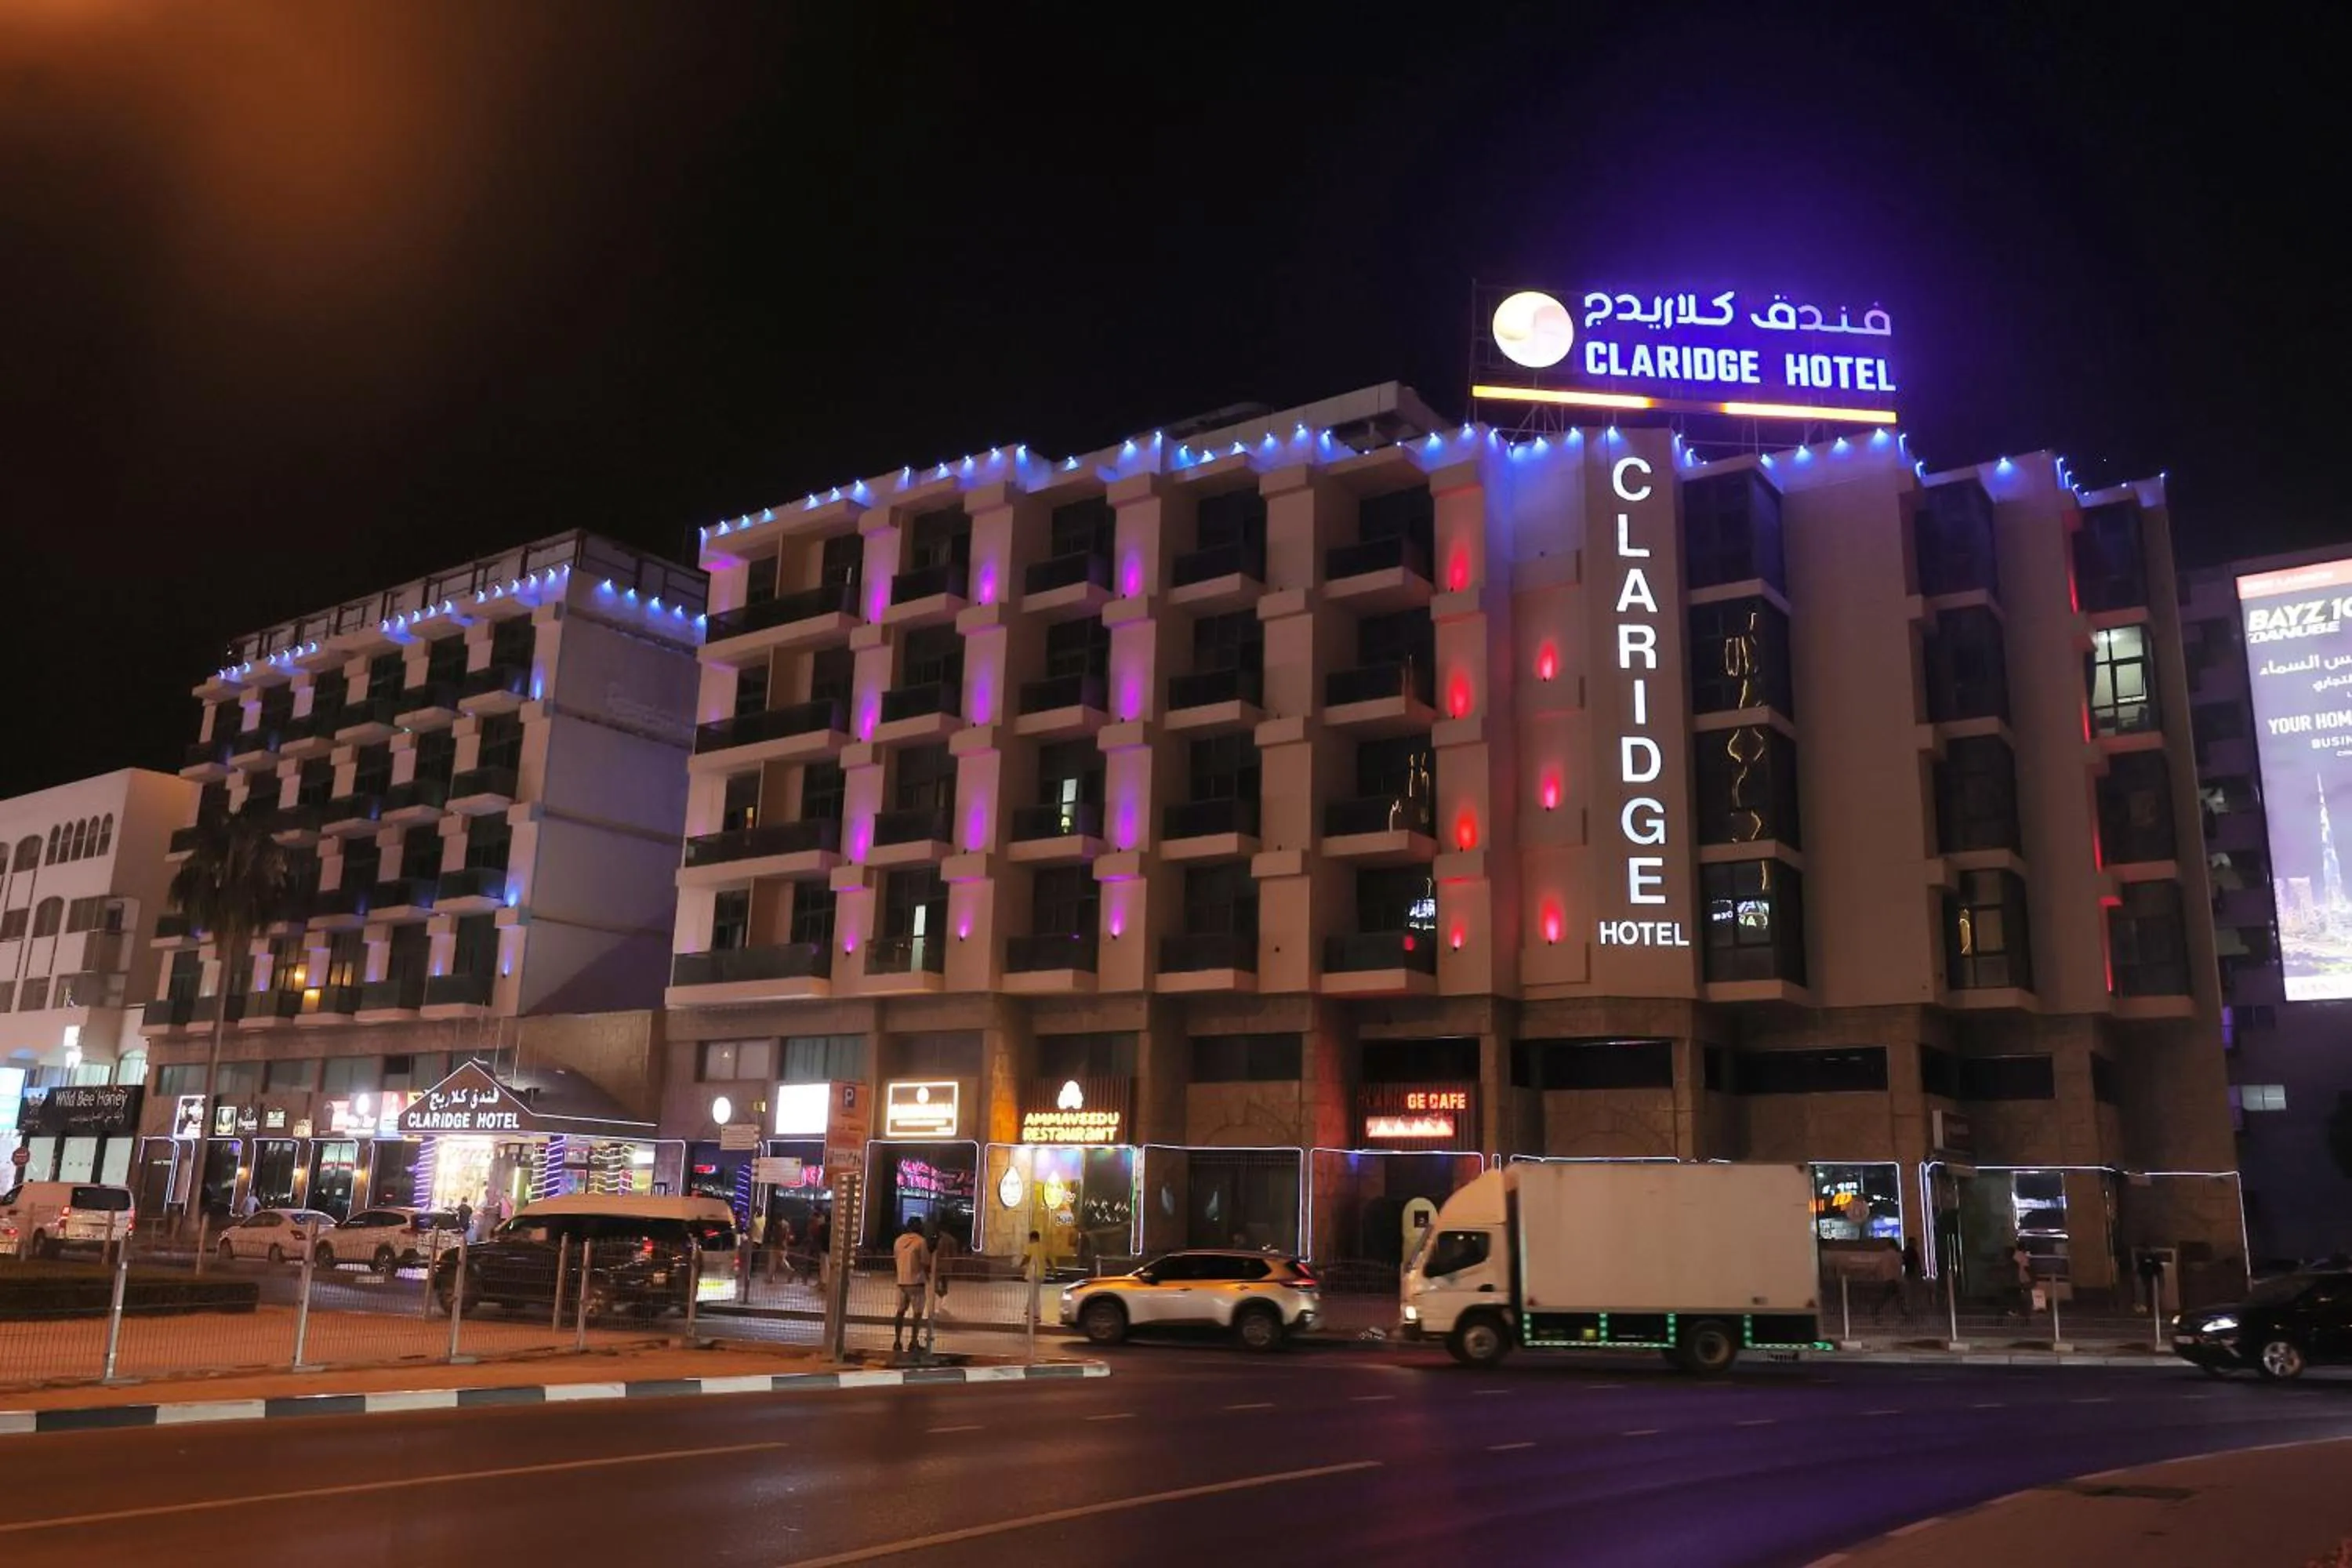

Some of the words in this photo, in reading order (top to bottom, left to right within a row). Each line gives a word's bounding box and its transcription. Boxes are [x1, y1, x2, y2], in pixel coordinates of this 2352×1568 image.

[1584, 291, 1735, 329] كلاريدج
[1751, 294, 1892, 336] فندق
[1584, 341, 1761, 383] CLARIDGE
[1784, 354, 1896, 391] HOTEL
[2248, 600, 2327, 632] BAYZ
[2248, 620, 2340, 643] DANUBE
[2259, 654, 2320, 675] السماء
[1613, 457, 1667, 903] CLARIDGE
[2267, 714, 2312, 735] YOUR
[1599, 921, 1690, 946] HOTEL
[56, 1091, 76, 1108] Wild
[77, 1091, 95, 1107] Bee
[96, 1090, 128, 1109] Honey
[844, 1087, 855, 1105] P
[1429, 1093, 1465, 1109] CAFE
[408, 1112, 470, 1128] CLARIDGE
[476, 1112, 520, 1128] HOTEL
[1024, 1112, 1120, 1126] AMMAVEEDU
